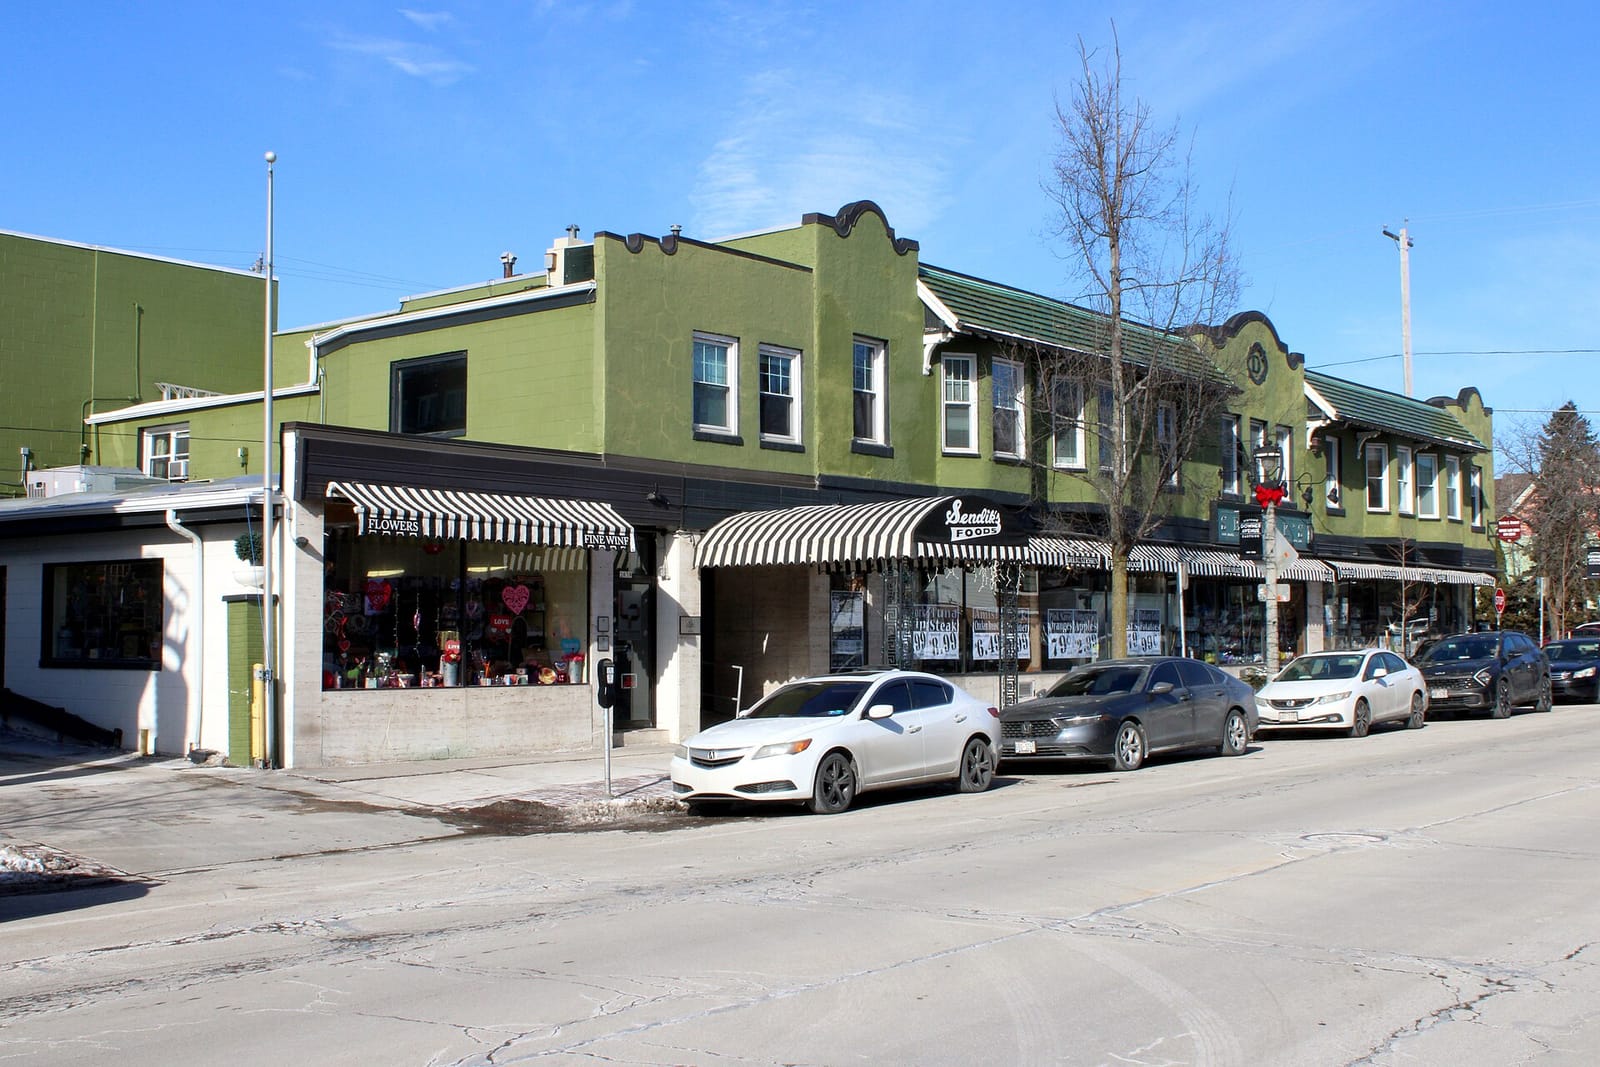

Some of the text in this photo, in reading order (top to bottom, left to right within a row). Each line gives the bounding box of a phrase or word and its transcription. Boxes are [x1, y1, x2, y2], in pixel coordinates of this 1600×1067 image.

[945, 499, 1001, 526] Sendik's
[368, 518, 419, 532] FLOWERS
[956, 527, 998, 538] FOODS
[584, 534, 606, 545] FINE
[1495, 596, 1504, 605] STOP
[931, 607, 957, 618] Tuna
[929, 619, 957, 632] Steak
[1075, 621, 1098, 634] Apples
